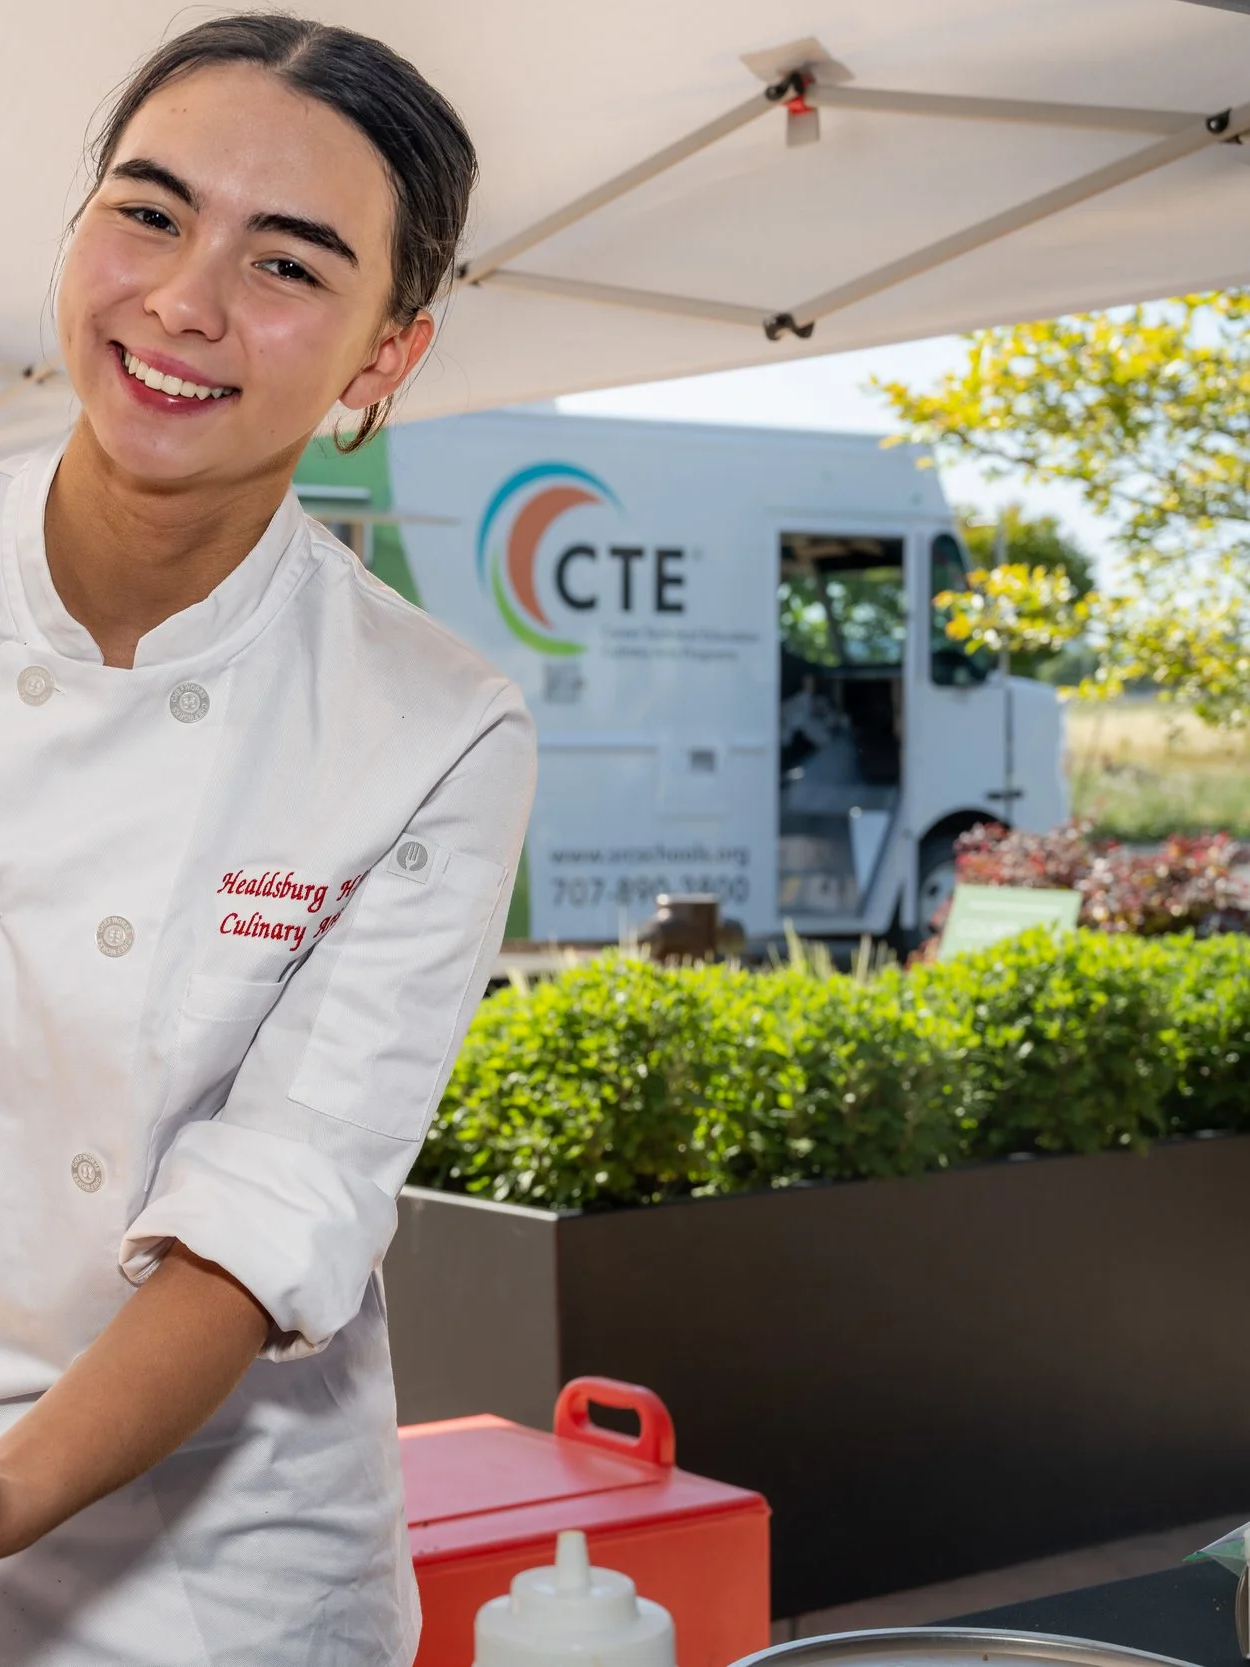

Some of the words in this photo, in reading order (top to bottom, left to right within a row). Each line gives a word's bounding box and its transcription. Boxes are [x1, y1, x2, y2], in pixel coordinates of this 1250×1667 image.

[553, 544, 685, 613] CTE
[217, 869, 328, 913] Healdsburg
[219, 912, 306, 951] Culinary
